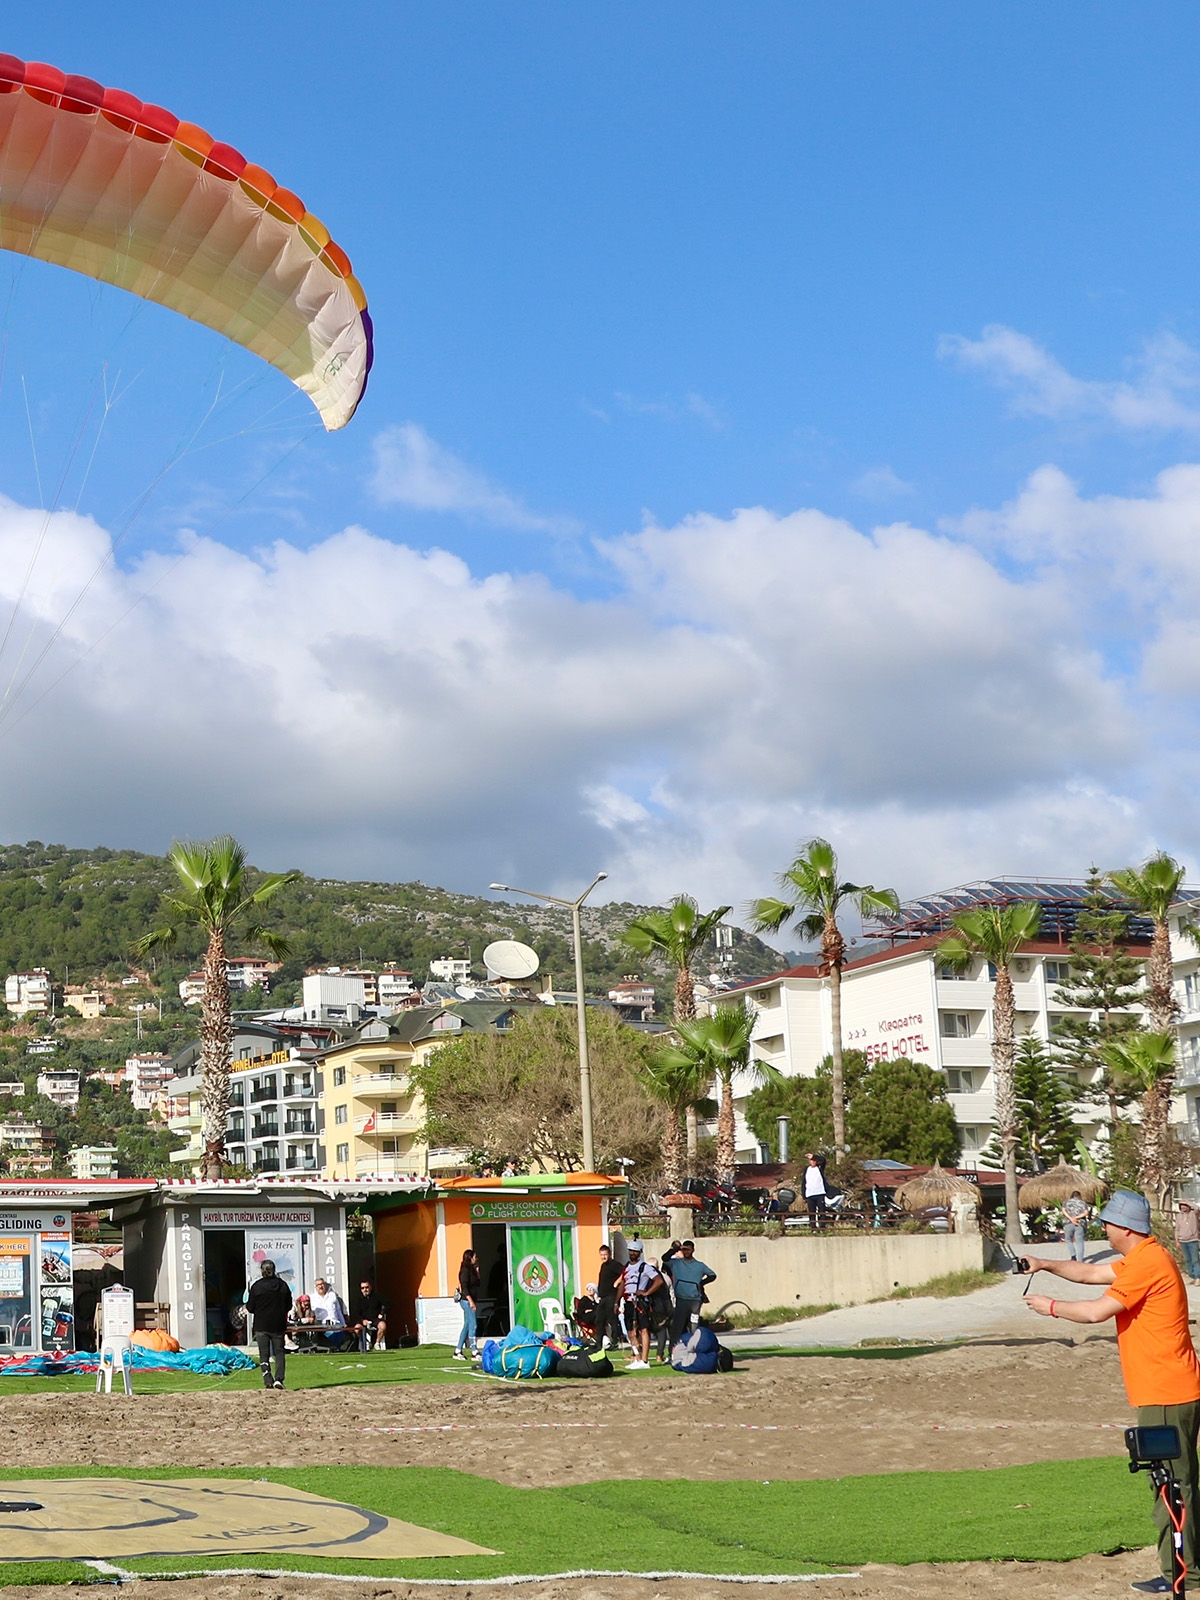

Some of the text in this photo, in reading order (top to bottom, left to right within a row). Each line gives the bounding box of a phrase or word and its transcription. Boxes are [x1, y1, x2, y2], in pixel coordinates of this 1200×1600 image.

[878, 1014, 923, 1033] Kleopatra
[892, 1034, 930, 1061] HOTEL
[272, 1050, 290, 1064] OTEL
[490, 1202, 515, 1210] UÇUŞ
[203, 1211, 311, 1223] HAYBİL TUR TURİZM VE SEYAHAT ACENTESİ
[6, 1243, 28, 1251] HERE
[253, 1241, 295, 1250] Book Here
